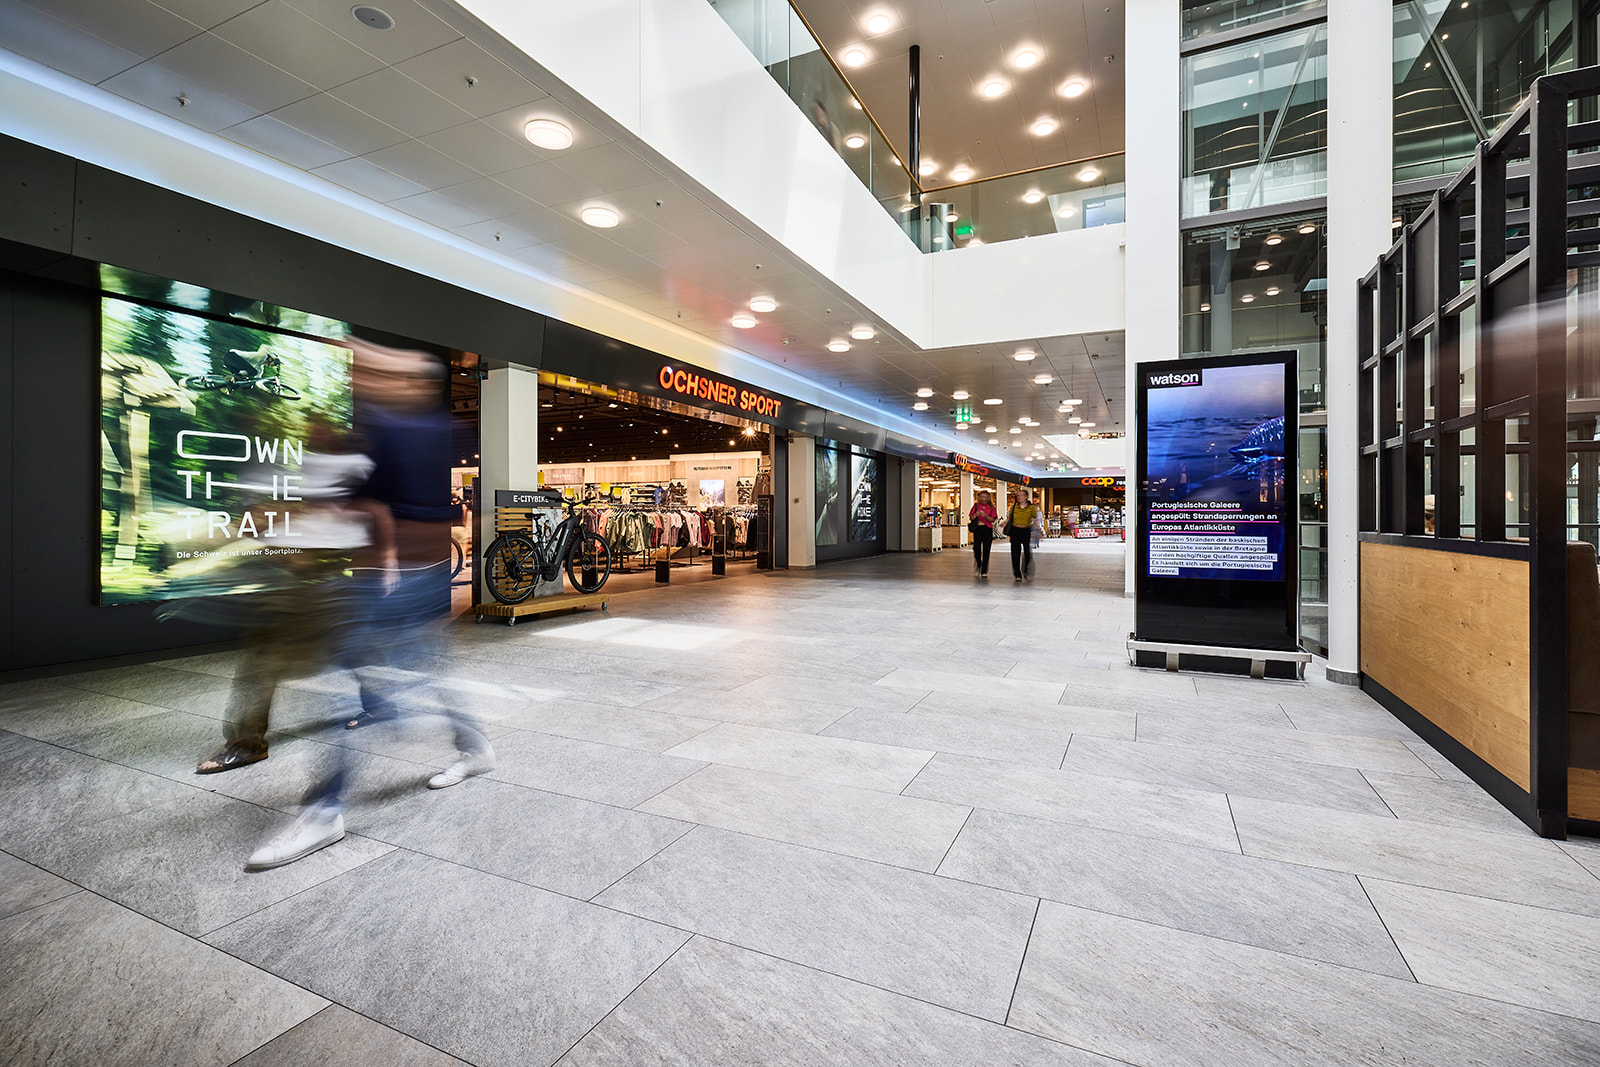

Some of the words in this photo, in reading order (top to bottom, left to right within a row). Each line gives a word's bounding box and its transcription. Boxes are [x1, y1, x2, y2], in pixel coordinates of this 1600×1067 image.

[1150, 373, 1199, 386] watson
[659, 365, 737, 406] OCHSNER
[740, 389, 782, 418] SPORT
[176, 429, 303, 466] OWN
[176, 469, 303, 501] THE
[1081, 477, 1115, 487] coop
[1151, 501, 1208, 510] Portugiesische
[1209, 501, 1241, 509] Galeere
[1151, 512, 1191, 521] angespült:
[1192, 512, 1265, 522] Strandsperrungen
[176, 511, 303, 539] TRAIL
[1151, 523, 1183, 532] Europas
[1183, 523, 1236, 531] Atlantikküste
[176, 551, 191, 559] Die
[193, 550, 227, 558] Schweiz
[241, 548, 262, 556] unser
[1222, 561, 1272, 569] Portugiesische
